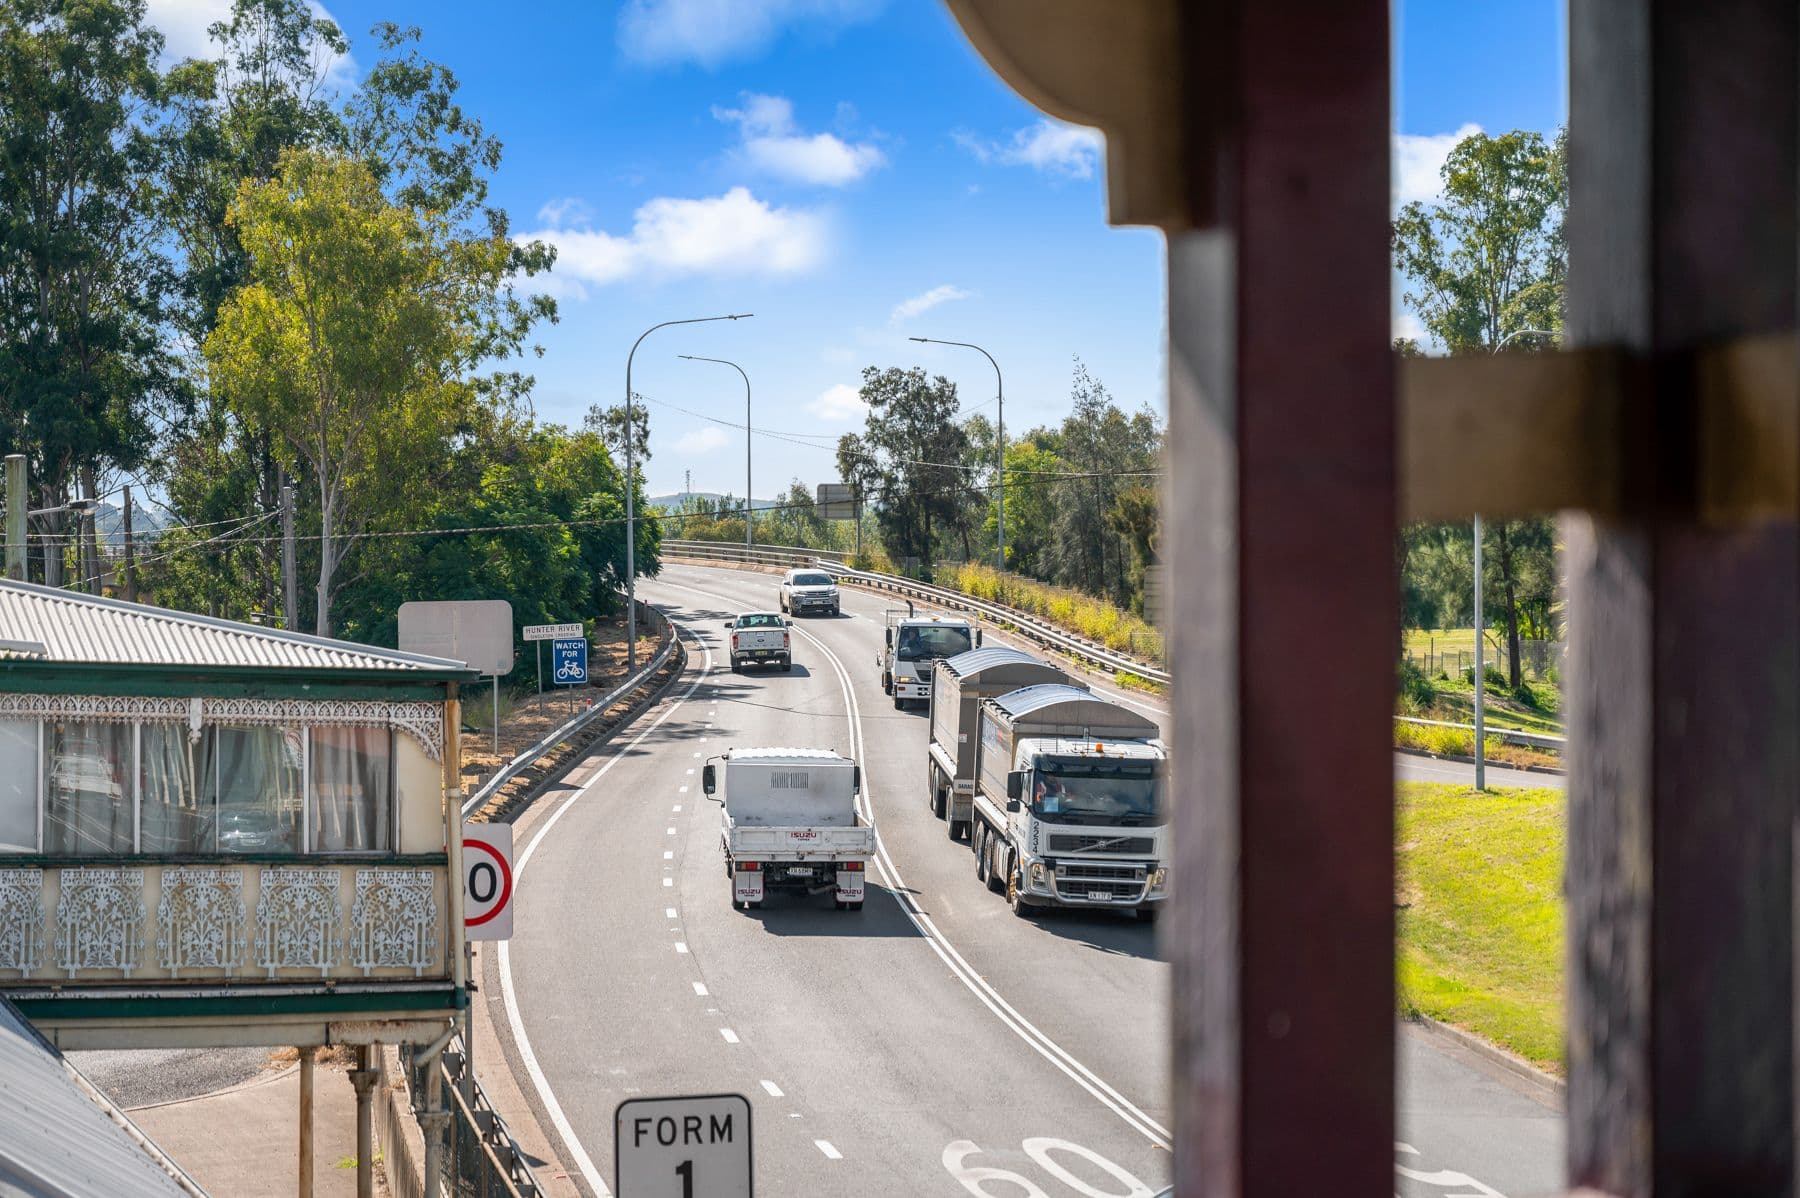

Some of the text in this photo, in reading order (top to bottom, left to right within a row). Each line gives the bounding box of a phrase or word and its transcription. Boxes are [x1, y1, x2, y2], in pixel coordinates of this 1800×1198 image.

[526, 626, 555, 634] HUNTER
[556, 642, 584, 650] WATCH
[464, 862, 497, 903] 0
[634, 1114, 733, 1148] FORM
[675, 1160, 693, 1198] 1
